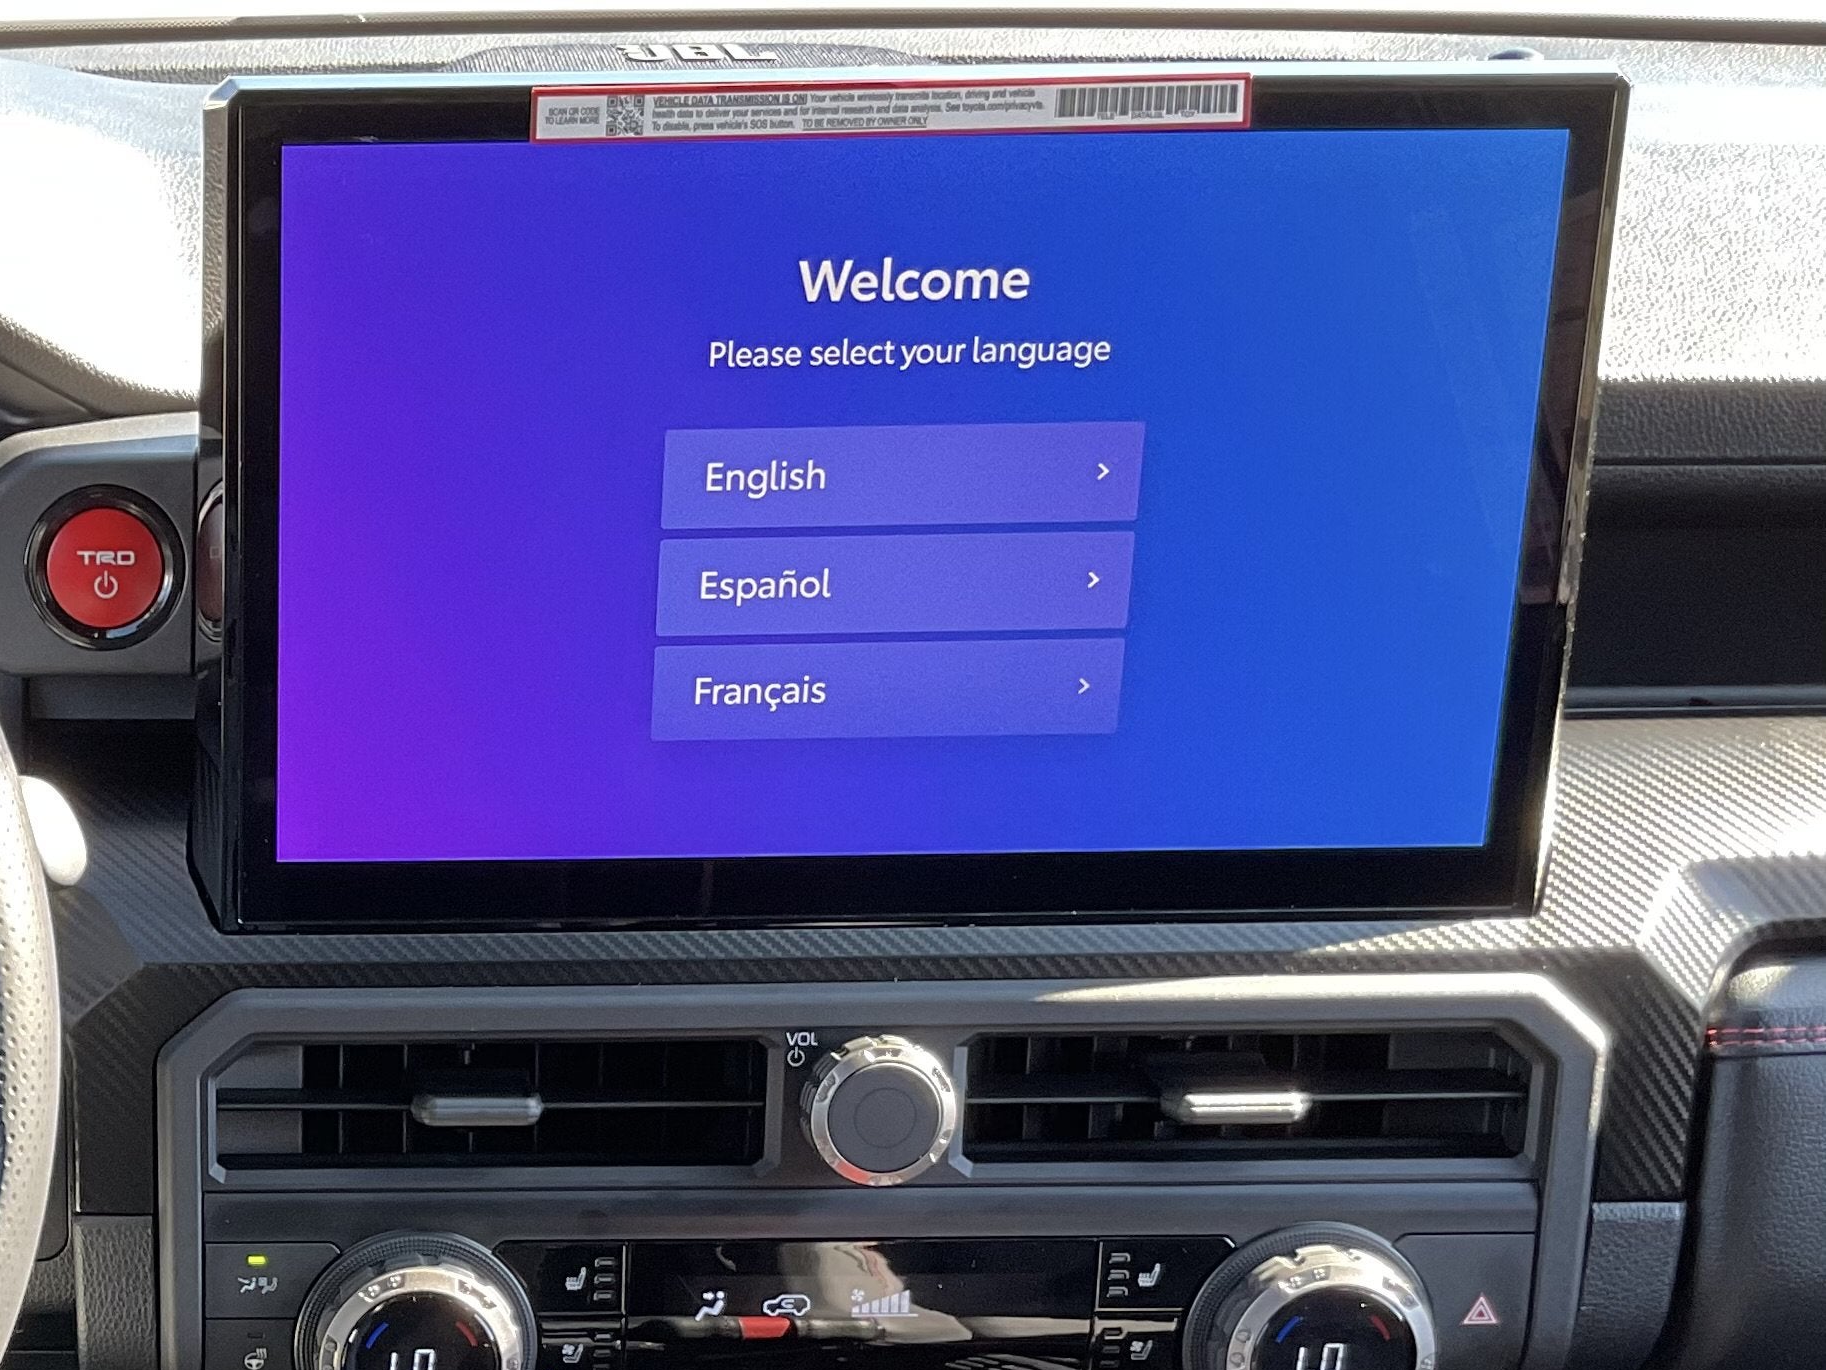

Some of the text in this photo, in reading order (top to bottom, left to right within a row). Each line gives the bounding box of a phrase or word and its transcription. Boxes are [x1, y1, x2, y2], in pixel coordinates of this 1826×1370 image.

[798, 256, 1031, 303] Welcome
[708, 336, 1112, 371] Please select your language
[704, 459, 827, 500] English
[76, 550, 136, 566] TRD
[698, 568, 832, 607] Español
[693, 675, 827, 711] Français
[786, 1031, 819, 1046] VOL
